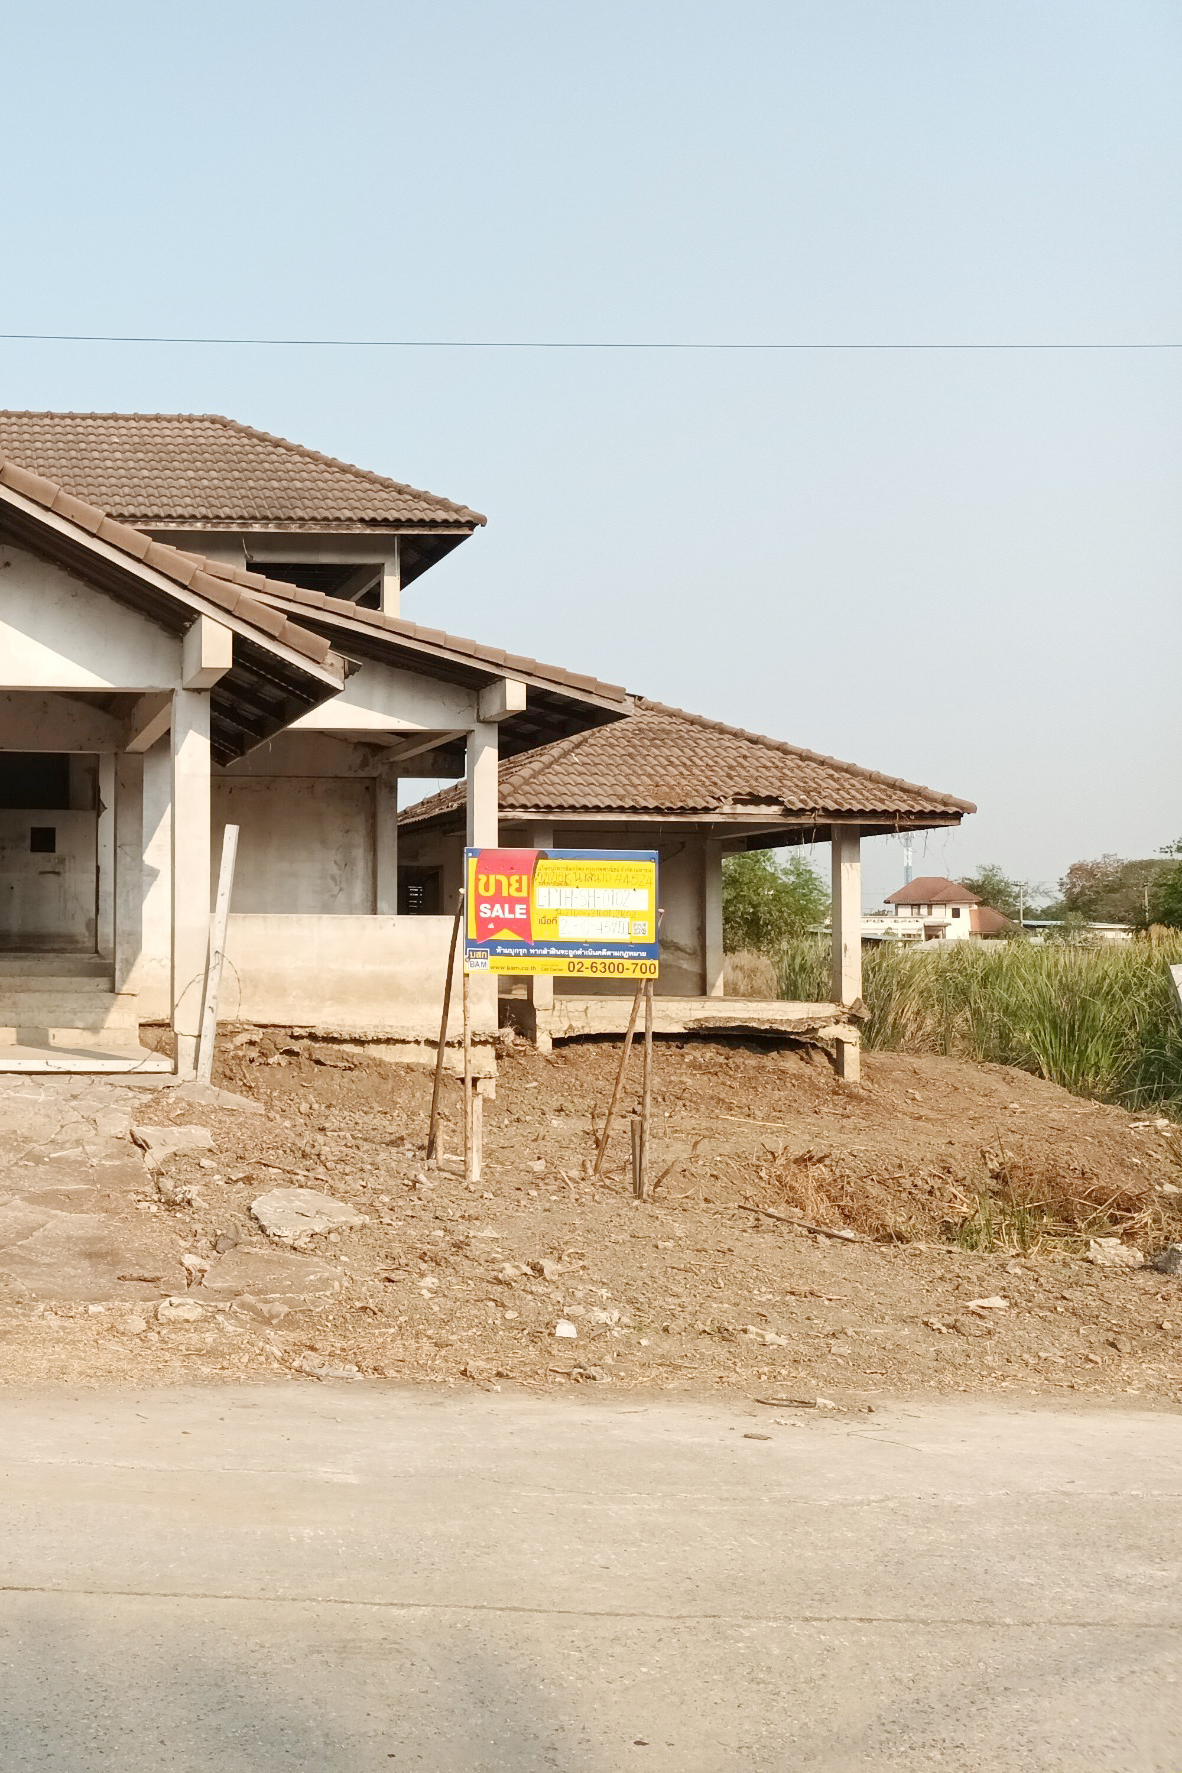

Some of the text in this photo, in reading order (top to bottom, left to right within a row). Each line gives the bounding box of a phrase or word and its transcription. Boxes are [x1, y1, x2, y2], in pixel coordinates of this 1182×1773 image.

[478, 874, 528, 897] ขาย
[615, 873, 653, 887] #4524
[479, 904, 527, 919] SALE
[469, 951, 488, 959] บสก
[495, 945, 528, 957] ห้ามบุกรุก
[567, 961, 657, 975] 02-6300-700
